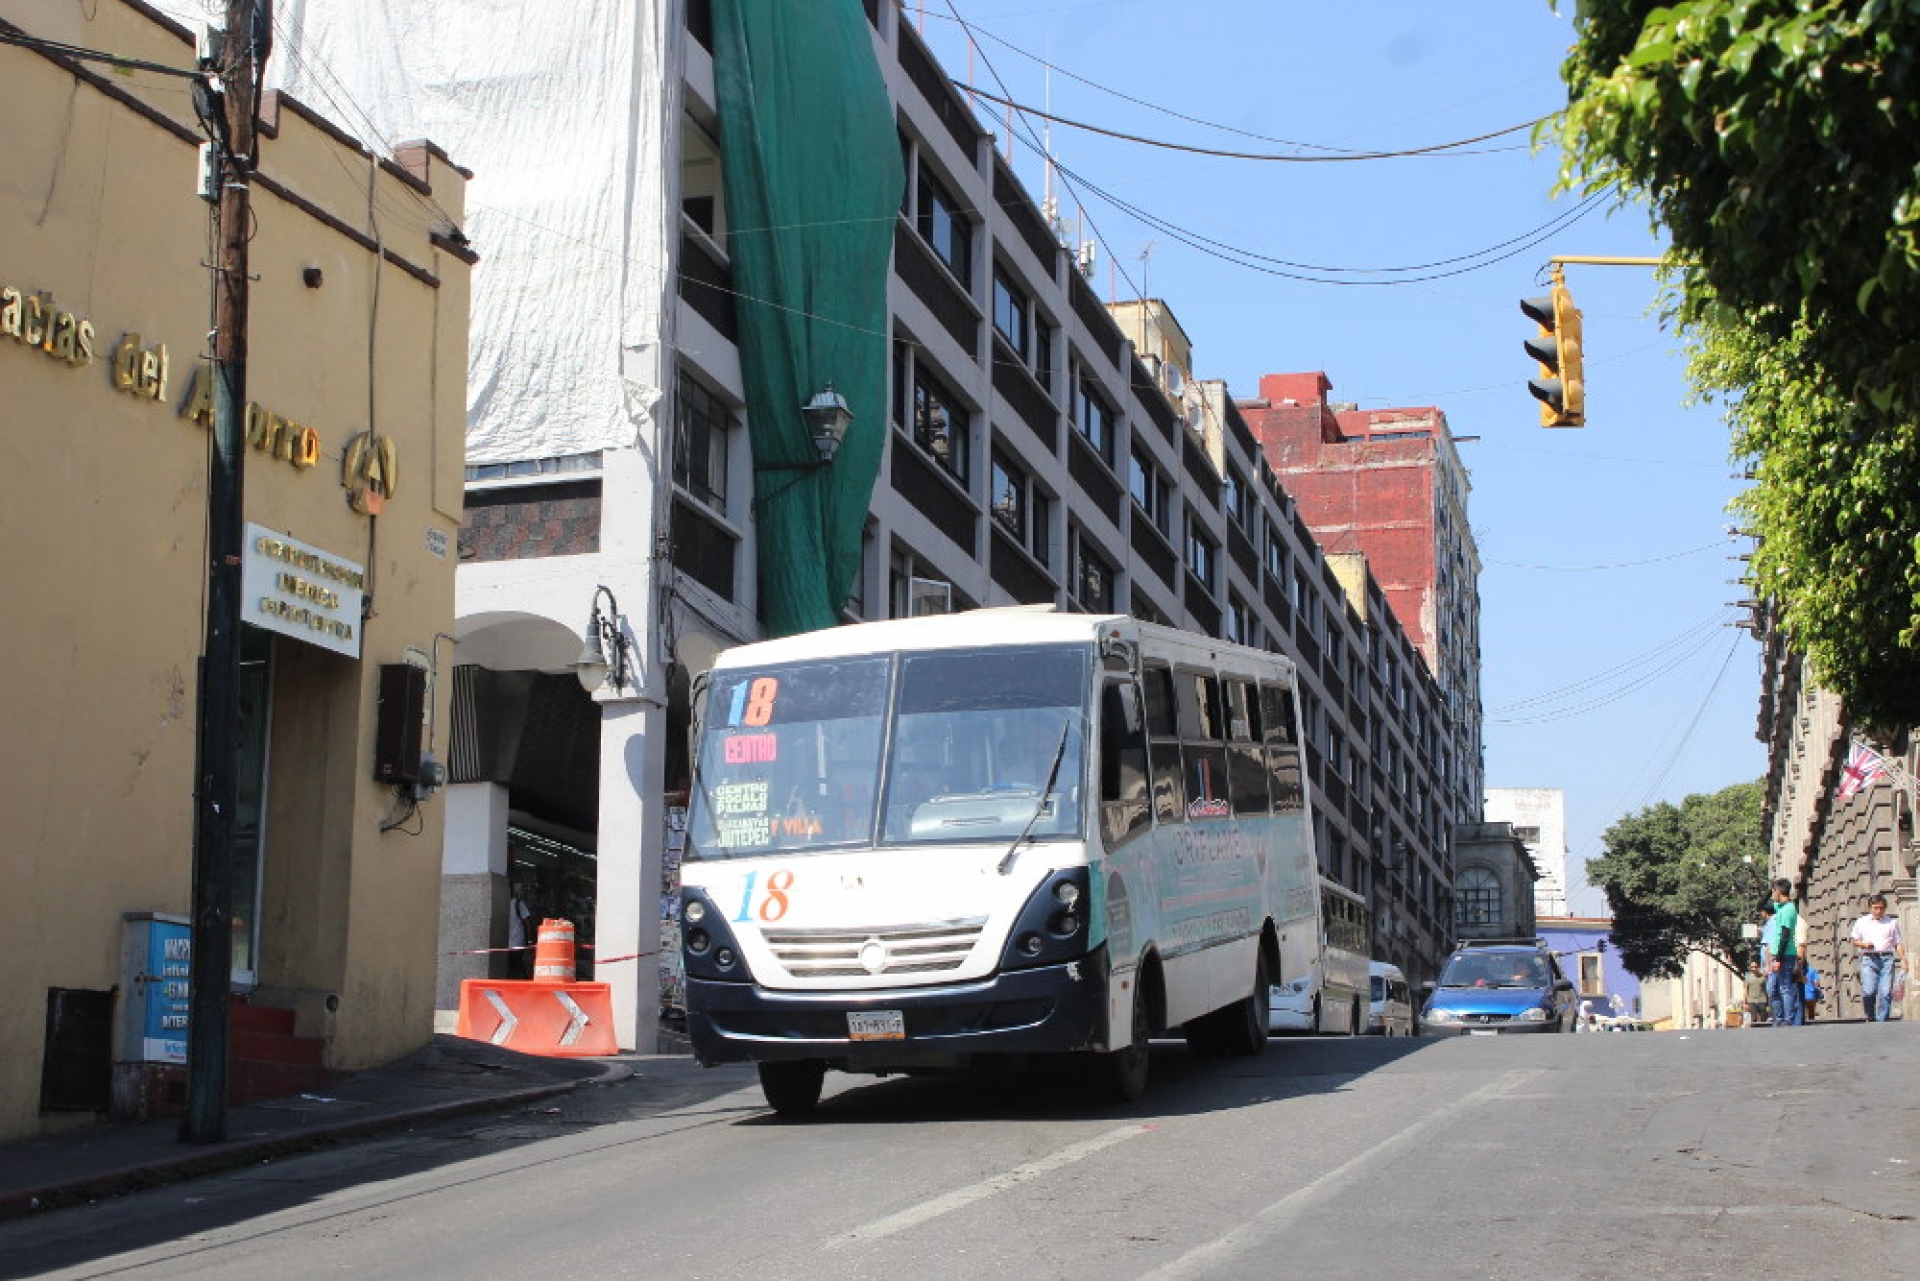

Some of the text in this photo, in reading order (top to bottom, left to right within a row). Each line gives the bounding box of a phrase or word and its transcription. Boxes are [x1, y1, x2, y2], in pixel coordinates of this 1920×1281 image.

[113, 331, 169, 402] del
[182, 363, 320, 471] Aorro
[728, 677, 778, 727] 18
[726, 734, 776, 764] CENTRO
[717, 828, 768, 848] JIUTEPEC
[731, 870, 794, 922] 18
